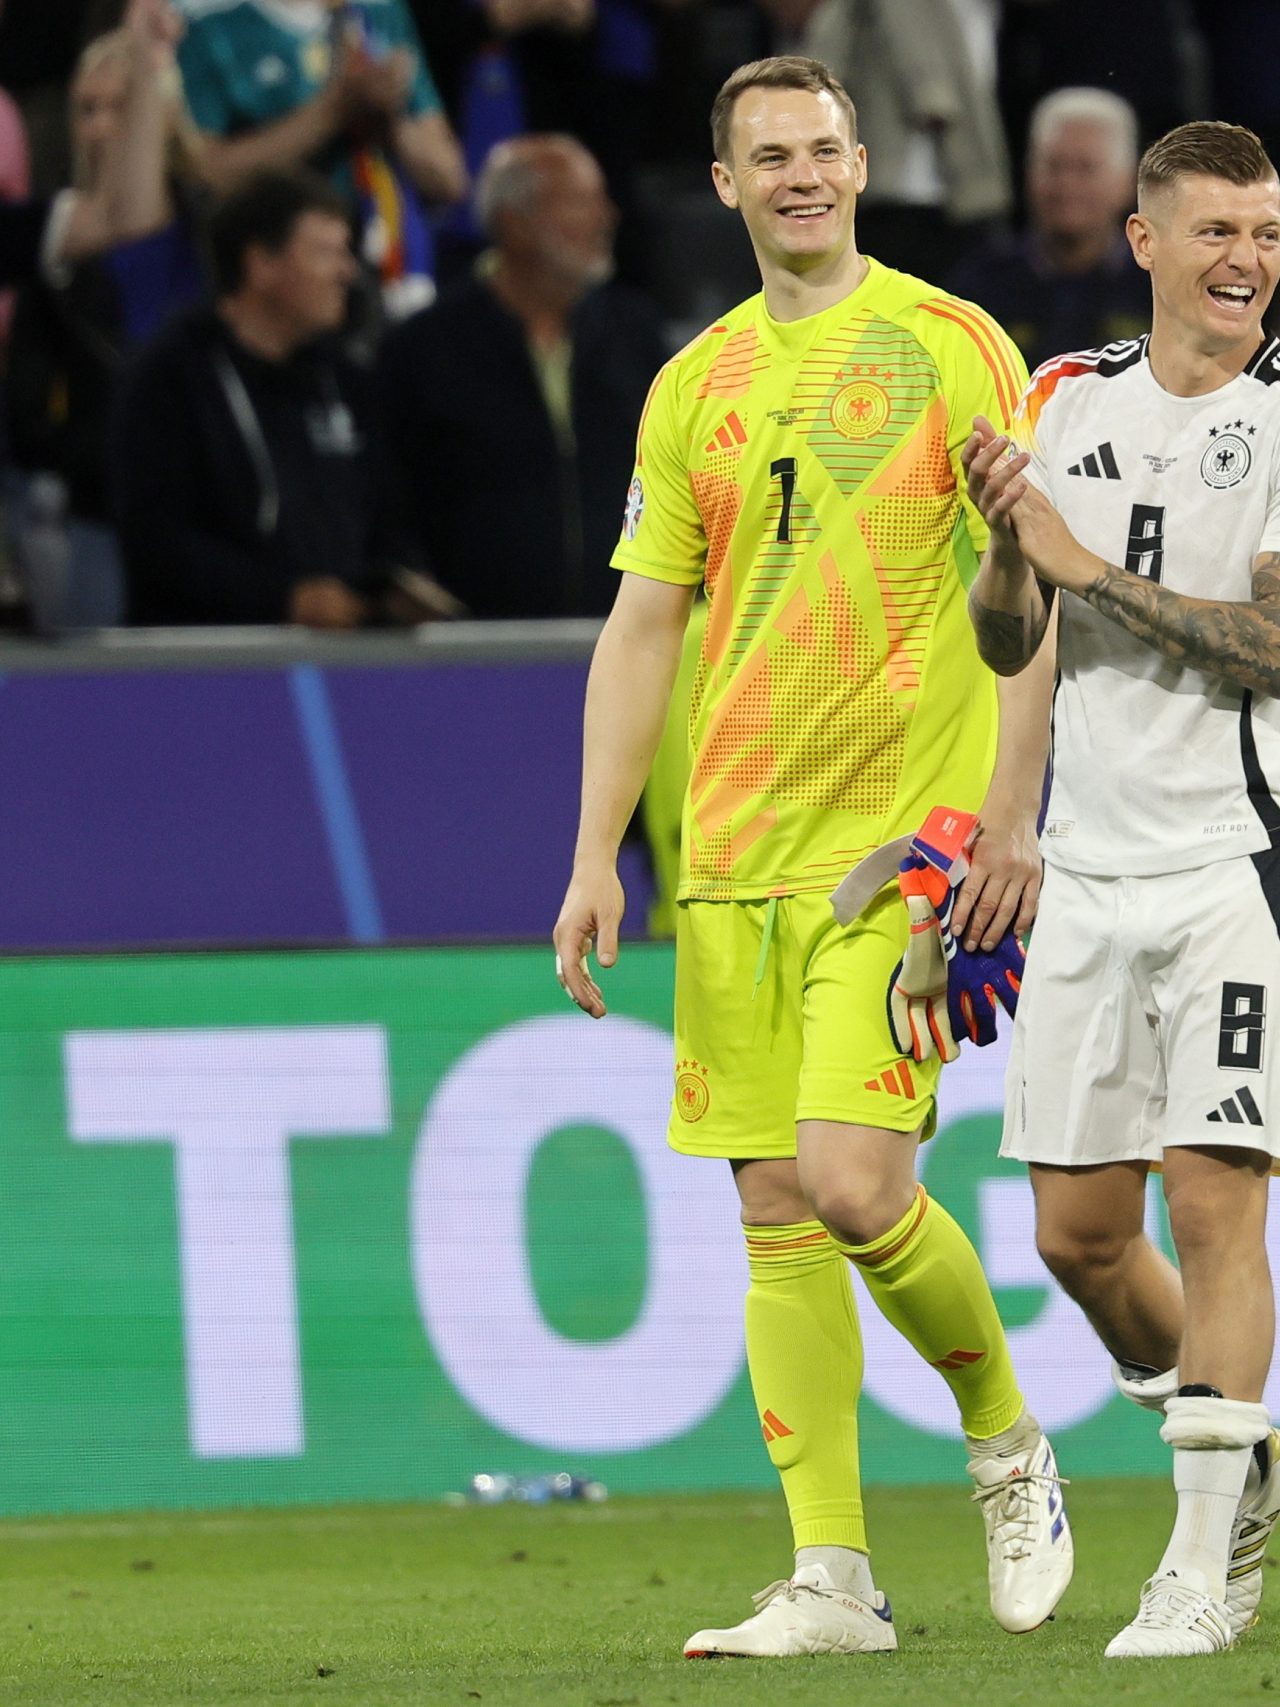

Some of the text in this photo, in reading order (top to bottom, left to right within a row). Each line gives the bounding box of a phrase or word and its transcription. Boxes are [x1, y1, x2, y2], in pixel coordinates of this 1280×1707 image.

[770, 457, 798, 544] 1
[1125, 503, 1166, 584] 8
[1217, 981, 1267, 1073] 8
[842, 1599, 864, 1613] COPA
